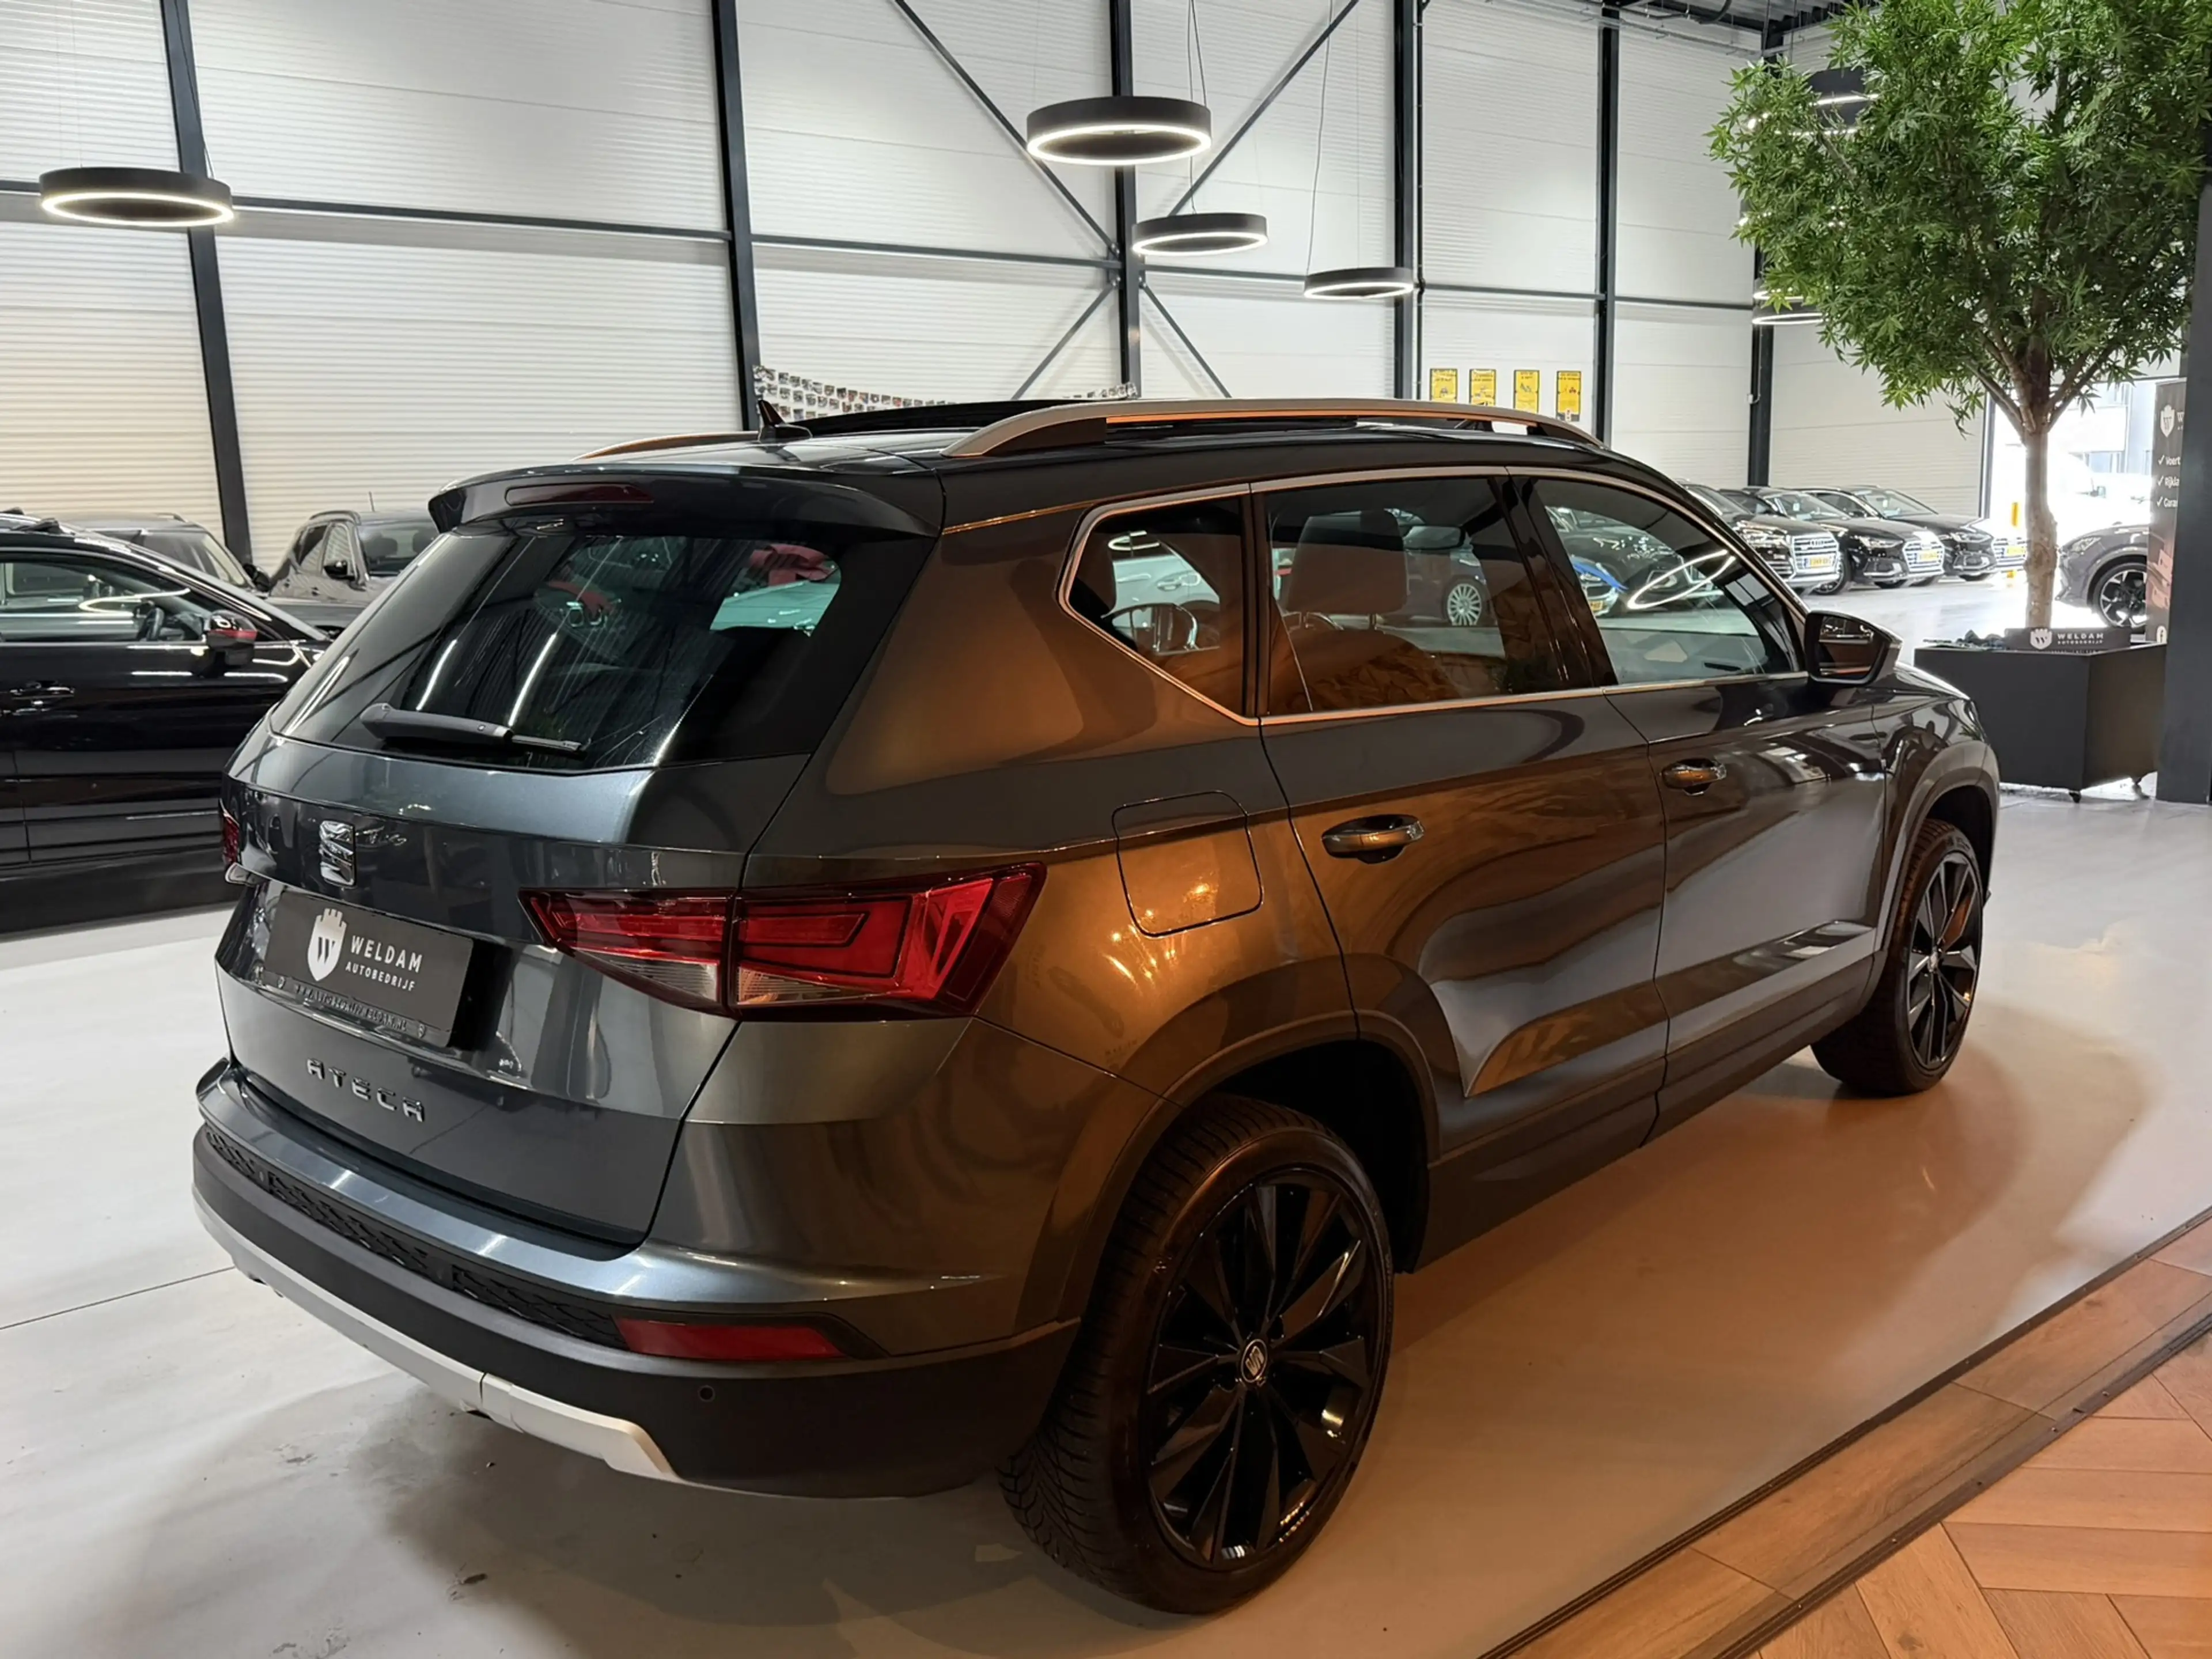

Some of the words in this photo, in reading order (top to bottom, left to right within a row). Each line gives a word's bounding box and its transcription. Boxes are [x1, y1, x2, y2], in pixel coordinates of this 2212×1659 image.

[350, 934, 423, 974] WELDAM
[345, 961, 416, 991] AUTOBEDRIJF
[306, 1058, 425, 1122] ATECA
